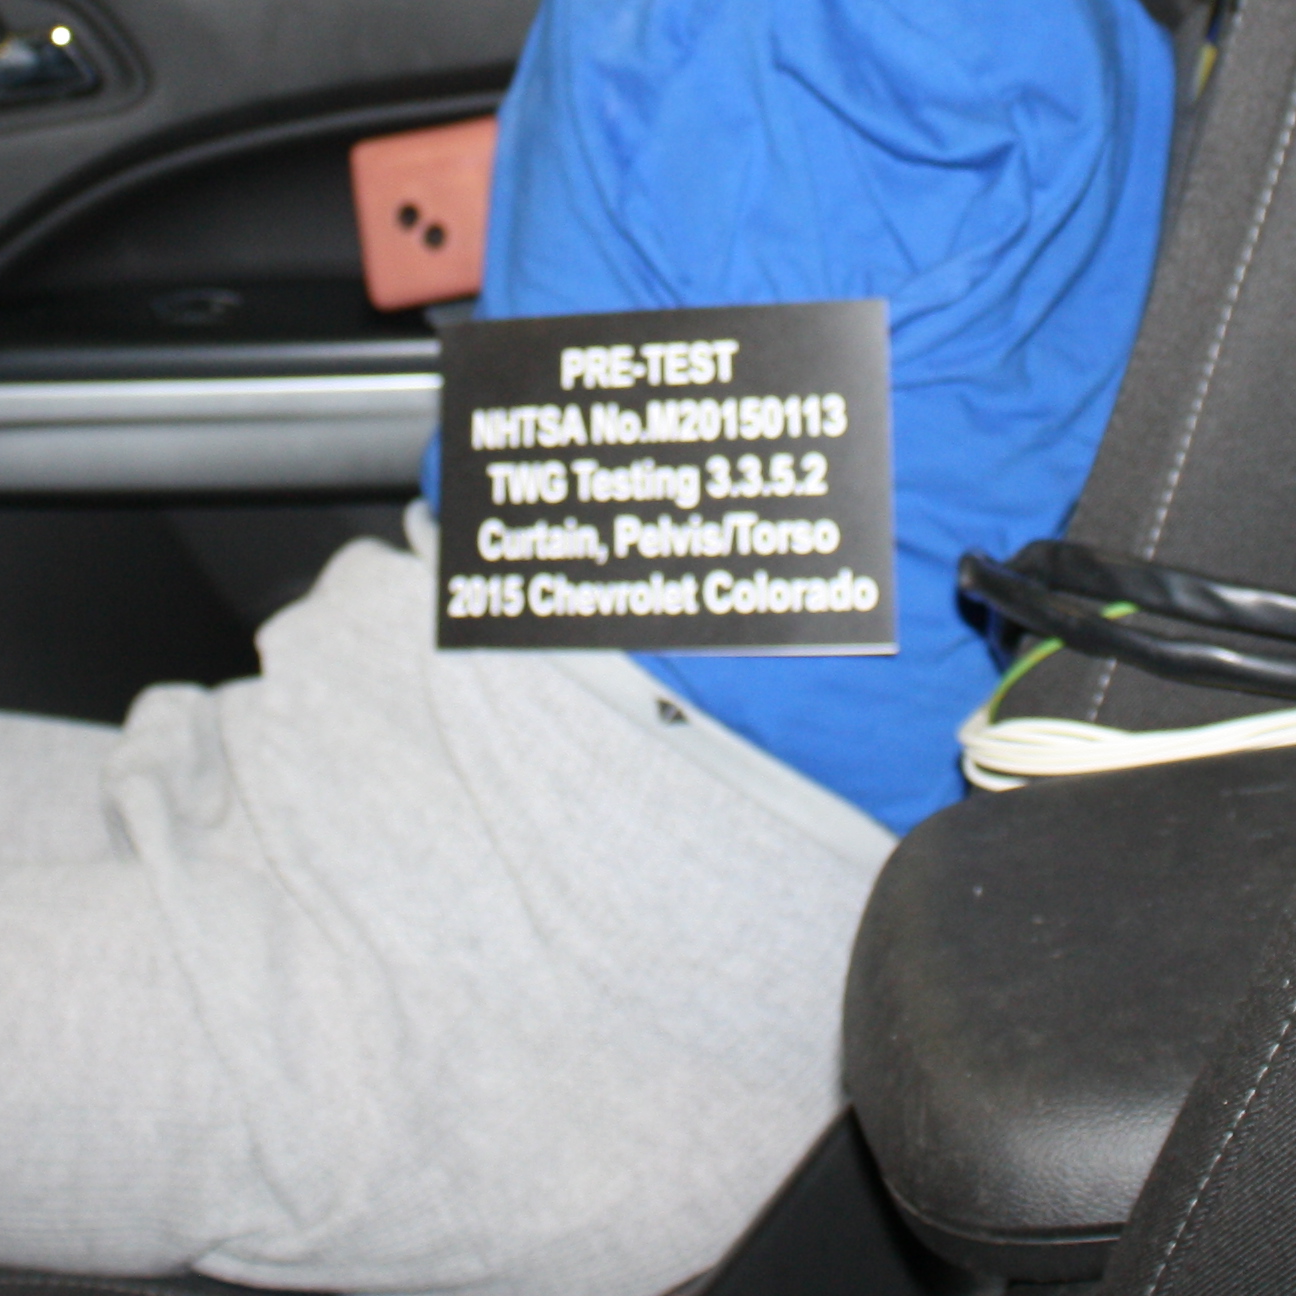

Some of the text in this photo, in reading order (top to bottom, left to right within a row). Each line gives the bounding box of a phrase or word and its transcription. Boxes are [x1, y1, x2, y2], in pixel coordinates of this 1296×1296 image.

[561, 339, 740, 390] PRE-TEST
[471, 393, 848, 450] NHTSA No.M20150113
[487, 452, 829, 509] TWG Testing 3.3.5.2
[478, 511, 841, 564] Curtain, Pelvis/Torso
[448, 568, 880, 618] 2015 Chevrolet Colorado
